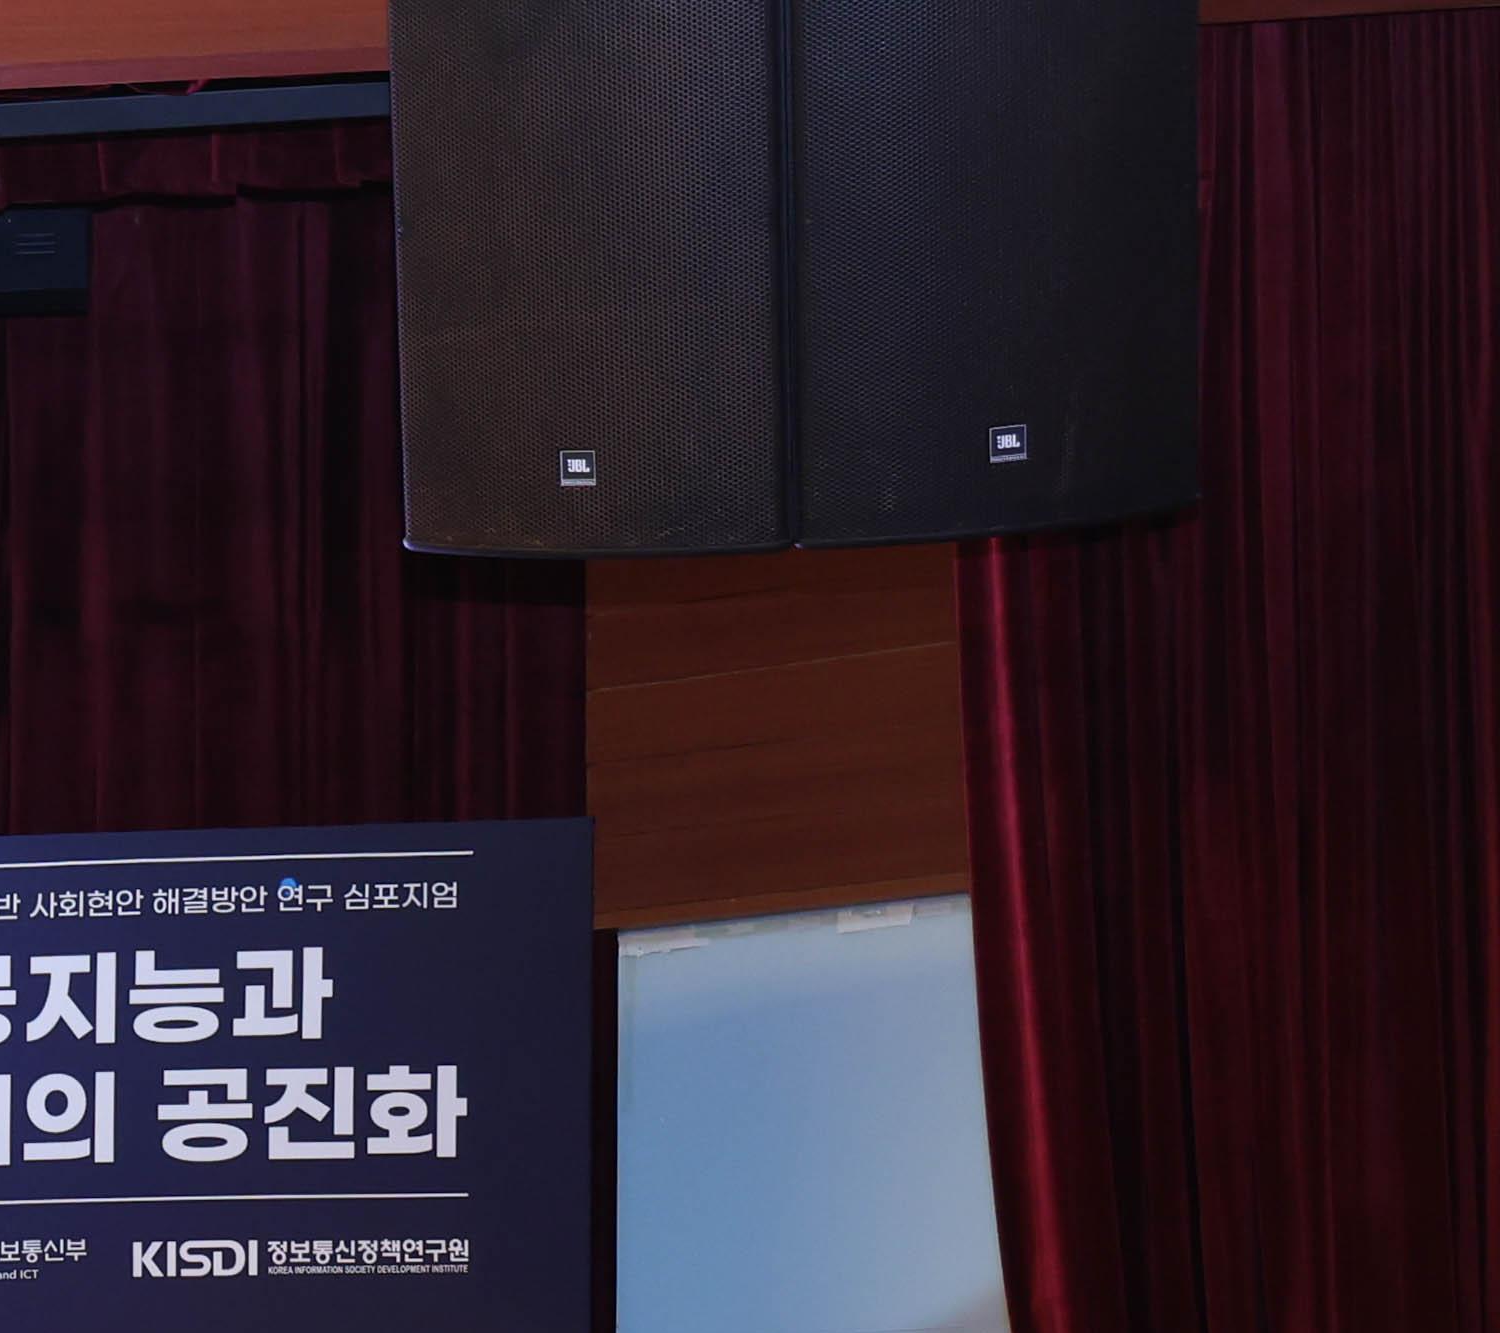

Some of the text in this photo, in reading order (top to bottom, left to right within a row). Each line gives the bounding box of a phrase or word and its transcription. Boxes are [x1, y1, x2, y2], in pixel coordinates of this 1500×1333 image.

[995, 434, 1021, 450] JBL
[567, 459, 591, 473] JBL
[29, 888, 145, 920] 사회현안
[152, 884, 268, 916] 해결방안
[278, 882, 335, 915] 연구
[343, 880, 459, 913] 심포지엄
[157, 1063, 468, 1162] 공진화
[132, 1239, 258, 1278] KISDI
[267, 1238, 469, 1264] 정보통신정책연구원
[19, 1269, 39, 1280] ICT
[268, 1266, 293, 1275] KOREA
[295, 1265, 343, 1274] INFORMATION
[345, 1265, 375, 1274] SOCIETY
